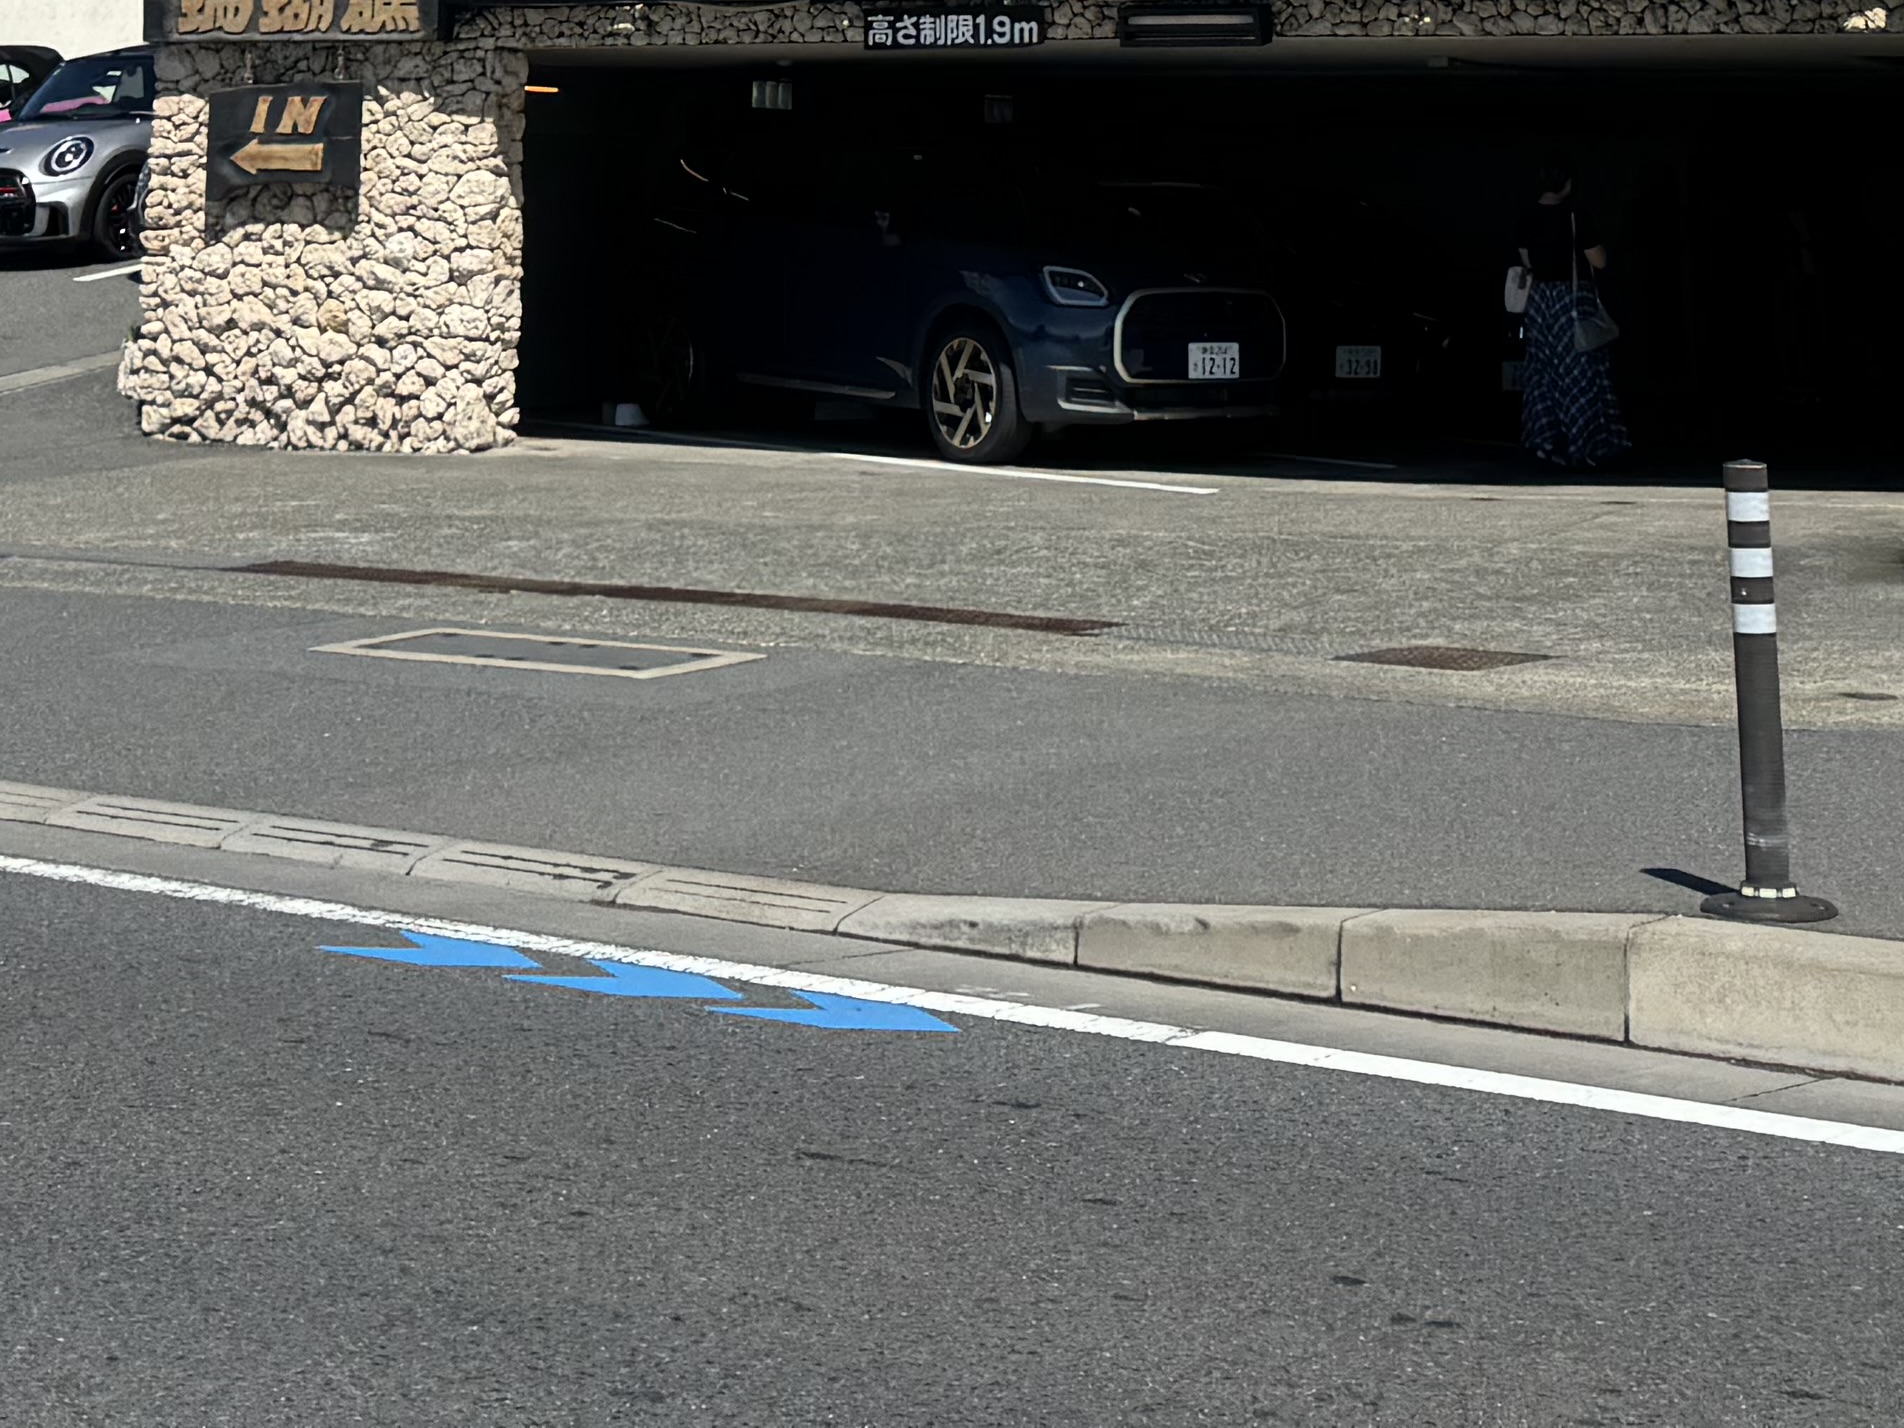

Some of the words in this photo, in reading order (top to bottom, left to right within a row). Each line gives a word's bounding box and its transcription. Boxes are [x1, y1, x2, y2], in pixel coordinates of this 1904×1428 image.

[867, 13, 1039, 46] 高さ制限1.9m
[249, 95, 327, 135] IN
